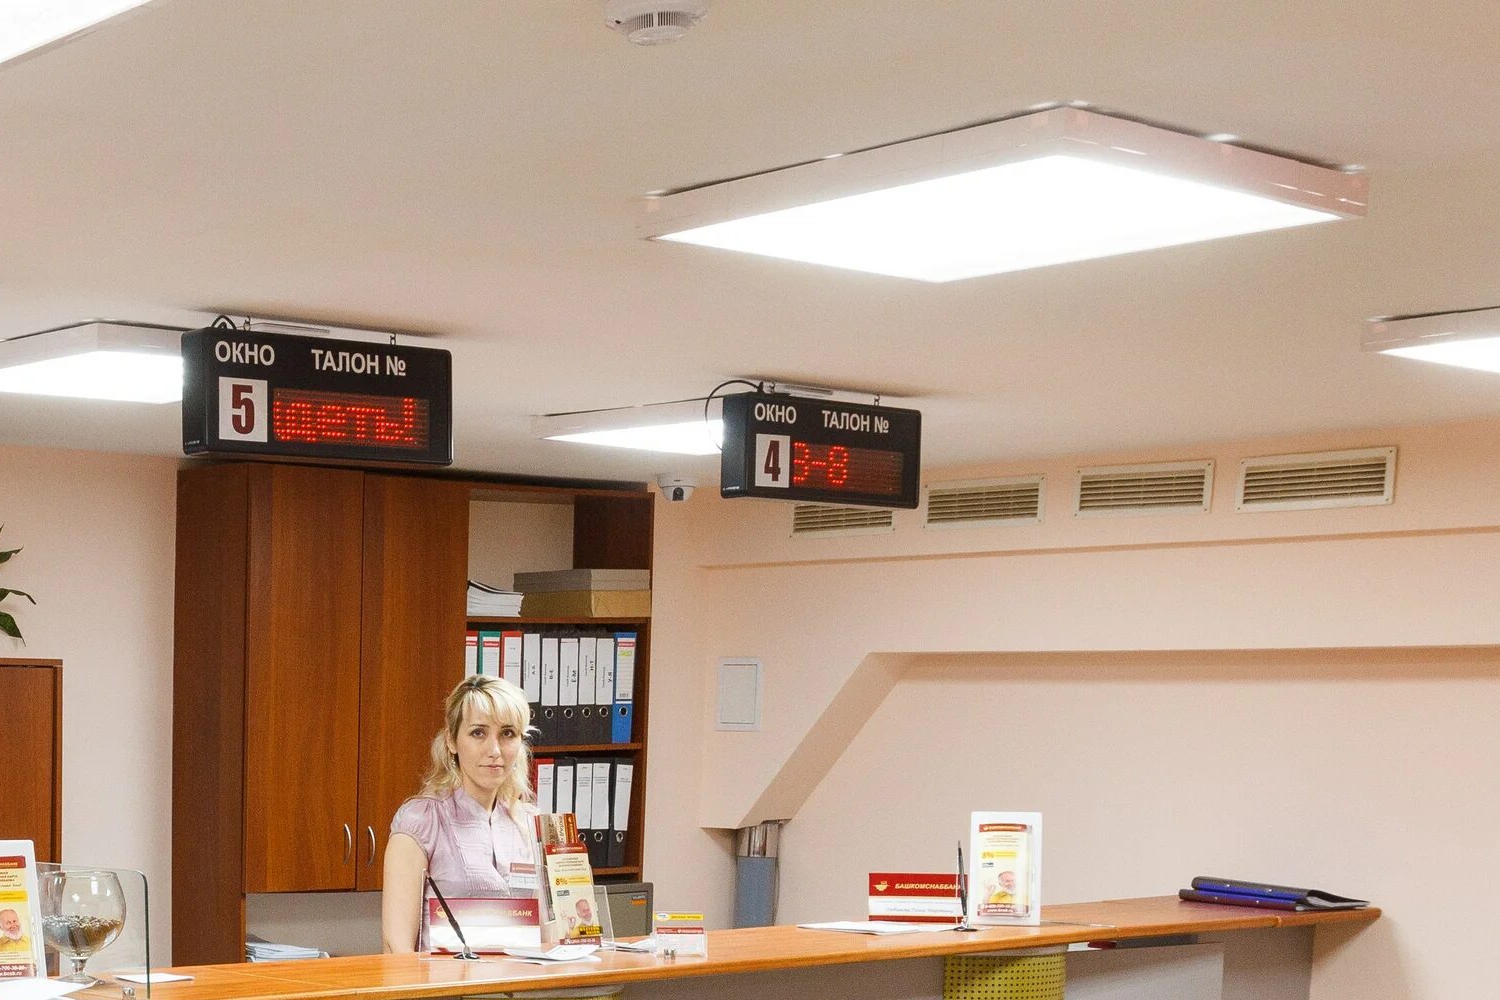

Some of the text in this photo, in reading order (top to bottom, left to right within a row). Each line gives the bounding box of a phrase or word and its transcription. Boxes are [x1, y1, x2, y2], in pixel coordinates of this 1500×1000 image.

[214, 340, 275, 366] ОКНО
[311, 349, 406, 376] ТАЛОН №
[231, 384, 255, 435] 5
[754, 403, 797, 424] ОКНО
[821, 410, 889, 433] ТАЛОН №
[764, 440, 781, 482] 4
